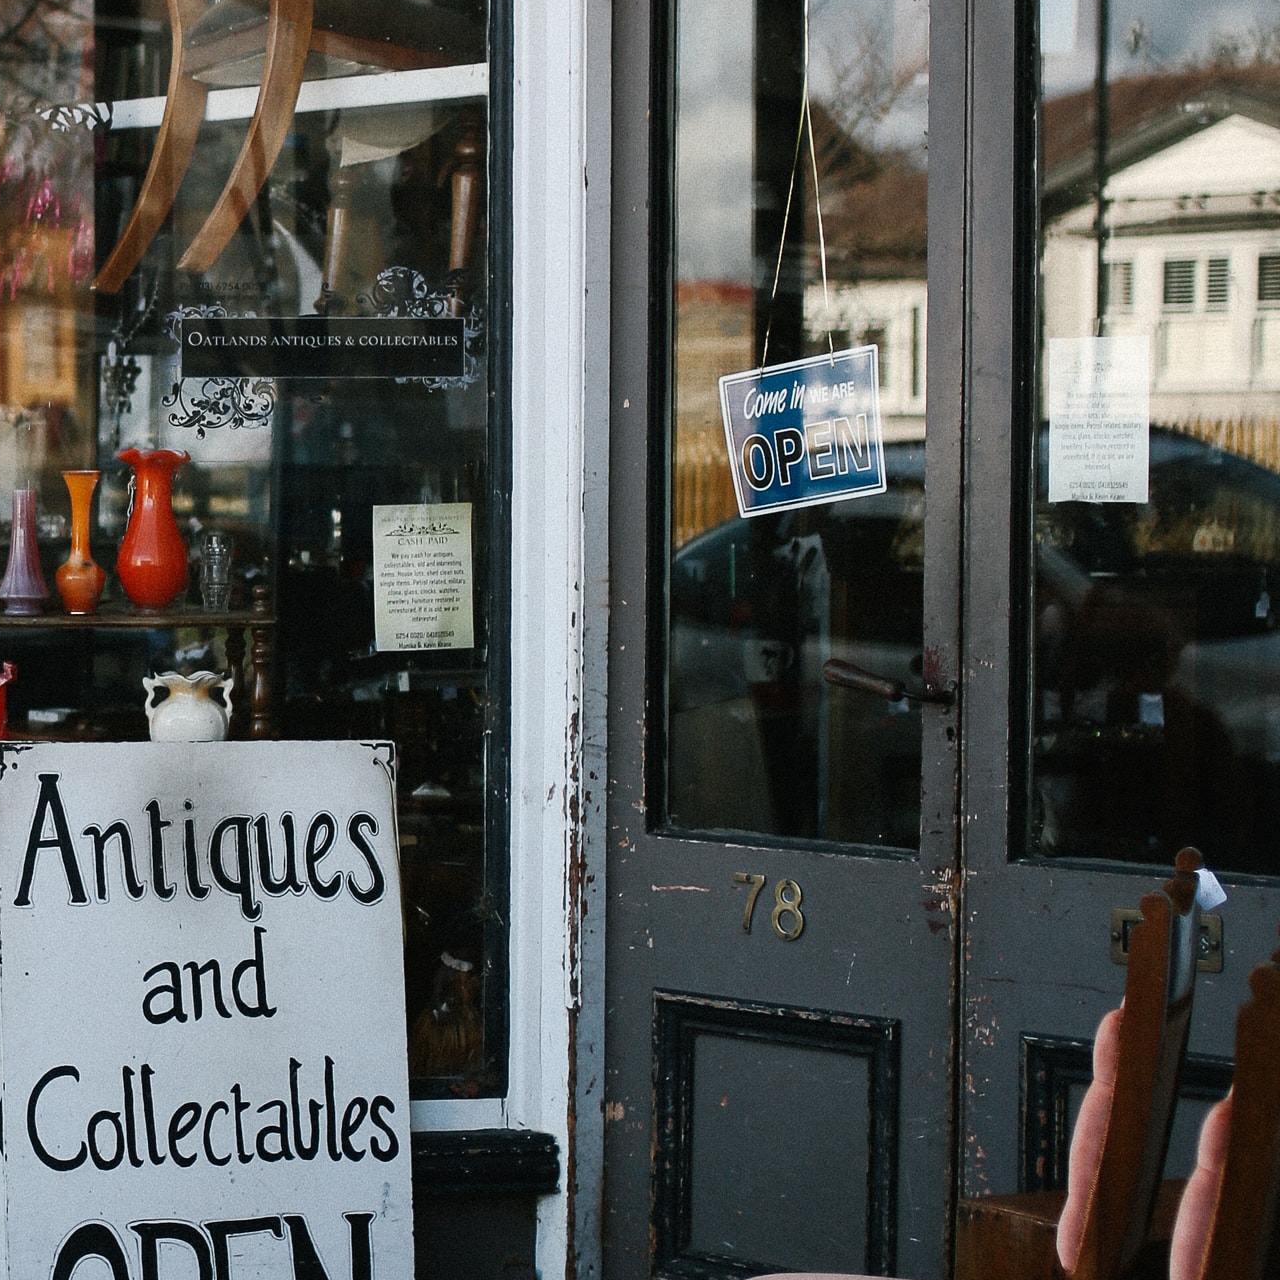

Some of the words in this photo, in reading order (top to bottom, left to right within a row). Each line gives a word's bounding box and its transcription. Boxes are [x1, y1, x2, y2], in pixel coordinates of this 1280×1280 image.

[270, 334, 342, 349] ANTIQUES
[345, 335, 356, 347] &
[358, 334, 459, 347] COLLECTABLES
[743, 386, 788, 420] Come
[789, 380, 806, 410] in
[809, 387, 830, 404] WE
[831, 381, 856, 400] ARE
[741, 412, 872, 492] OPEN
[398, 537, 423, 545] CASH
[14, 774, 385, 919] Antiques
[733, 871, 804, 941] 78
[142, 926, 278, 1024] and
[26, 1055, 400, 1172] Collectables
